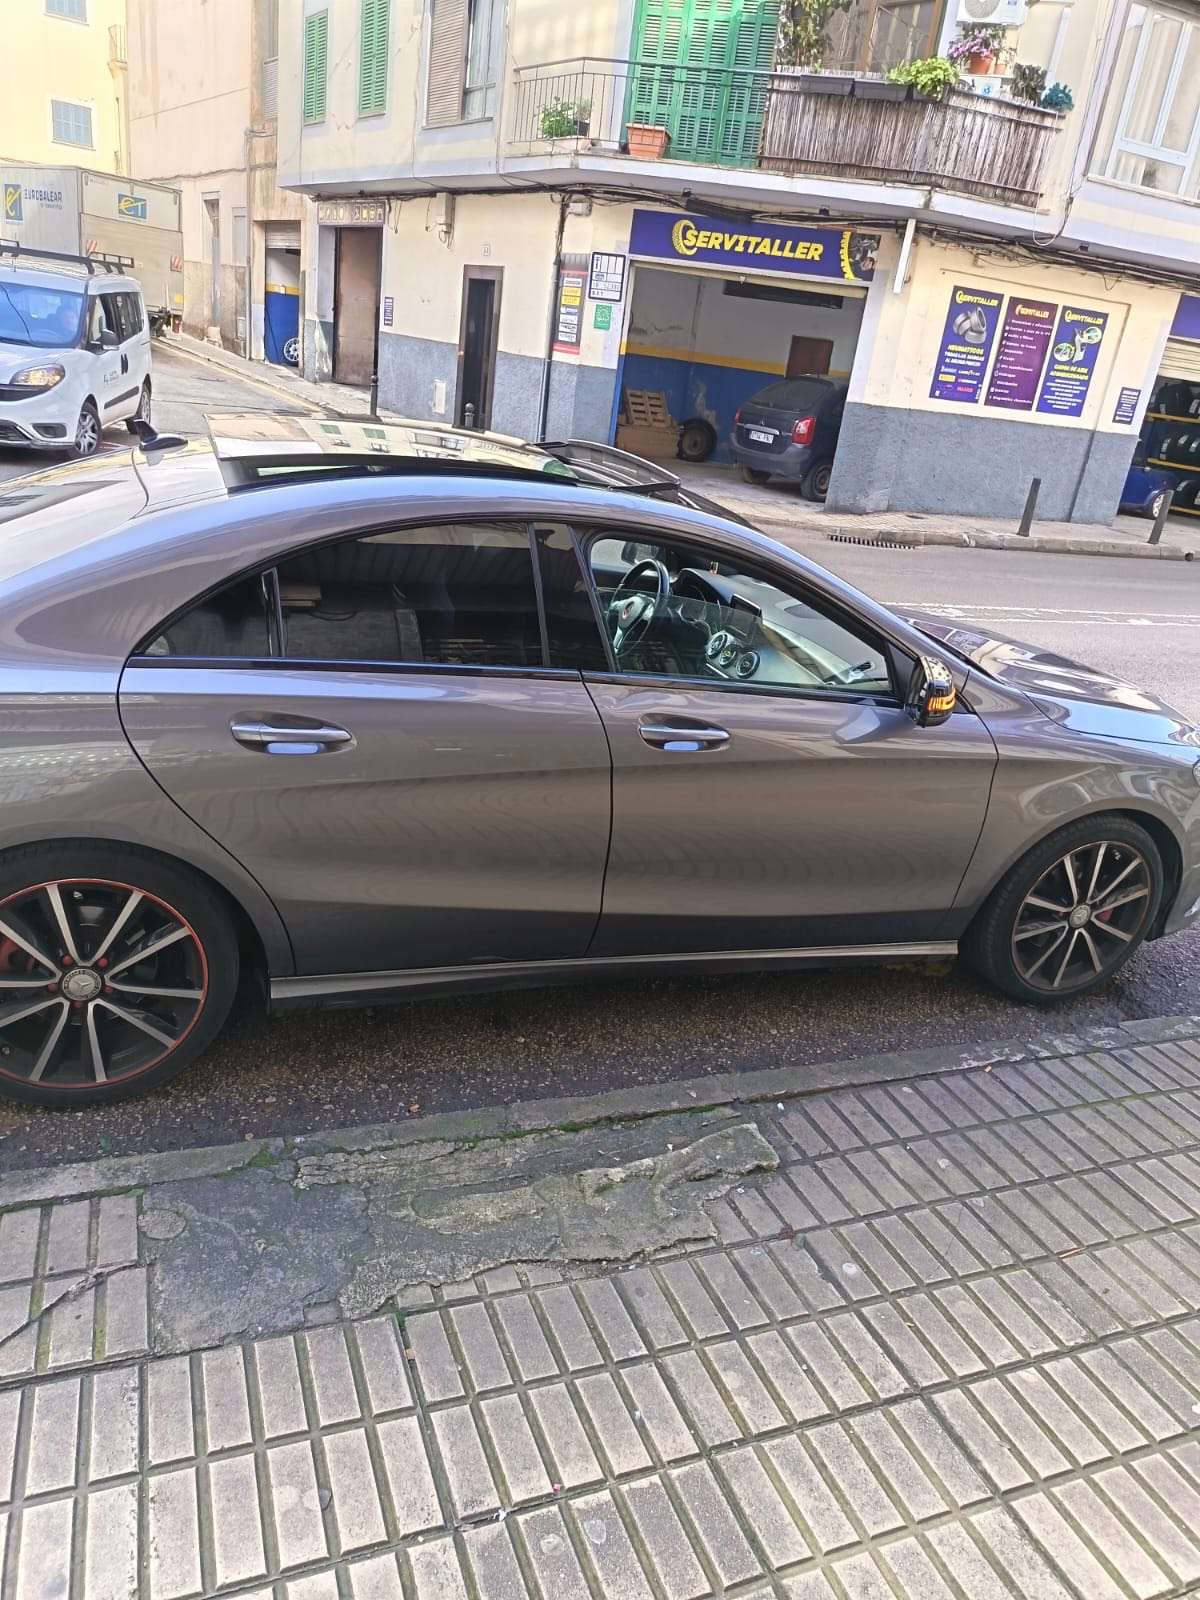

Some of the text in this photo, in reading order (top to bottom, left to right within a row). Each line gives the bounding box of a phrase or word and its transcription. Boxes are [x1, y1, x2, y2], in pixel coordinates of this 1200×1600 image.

[24, 188, 63, 203] EUROBALEAR
[684, 229, 824, 261] SERVITALLER
[958, 293, 999, 307] SERVITALLER
[1020, 307, 1050, 319] SERVITALLER
[1069, 312, 1104, 325] SERVITALLER
